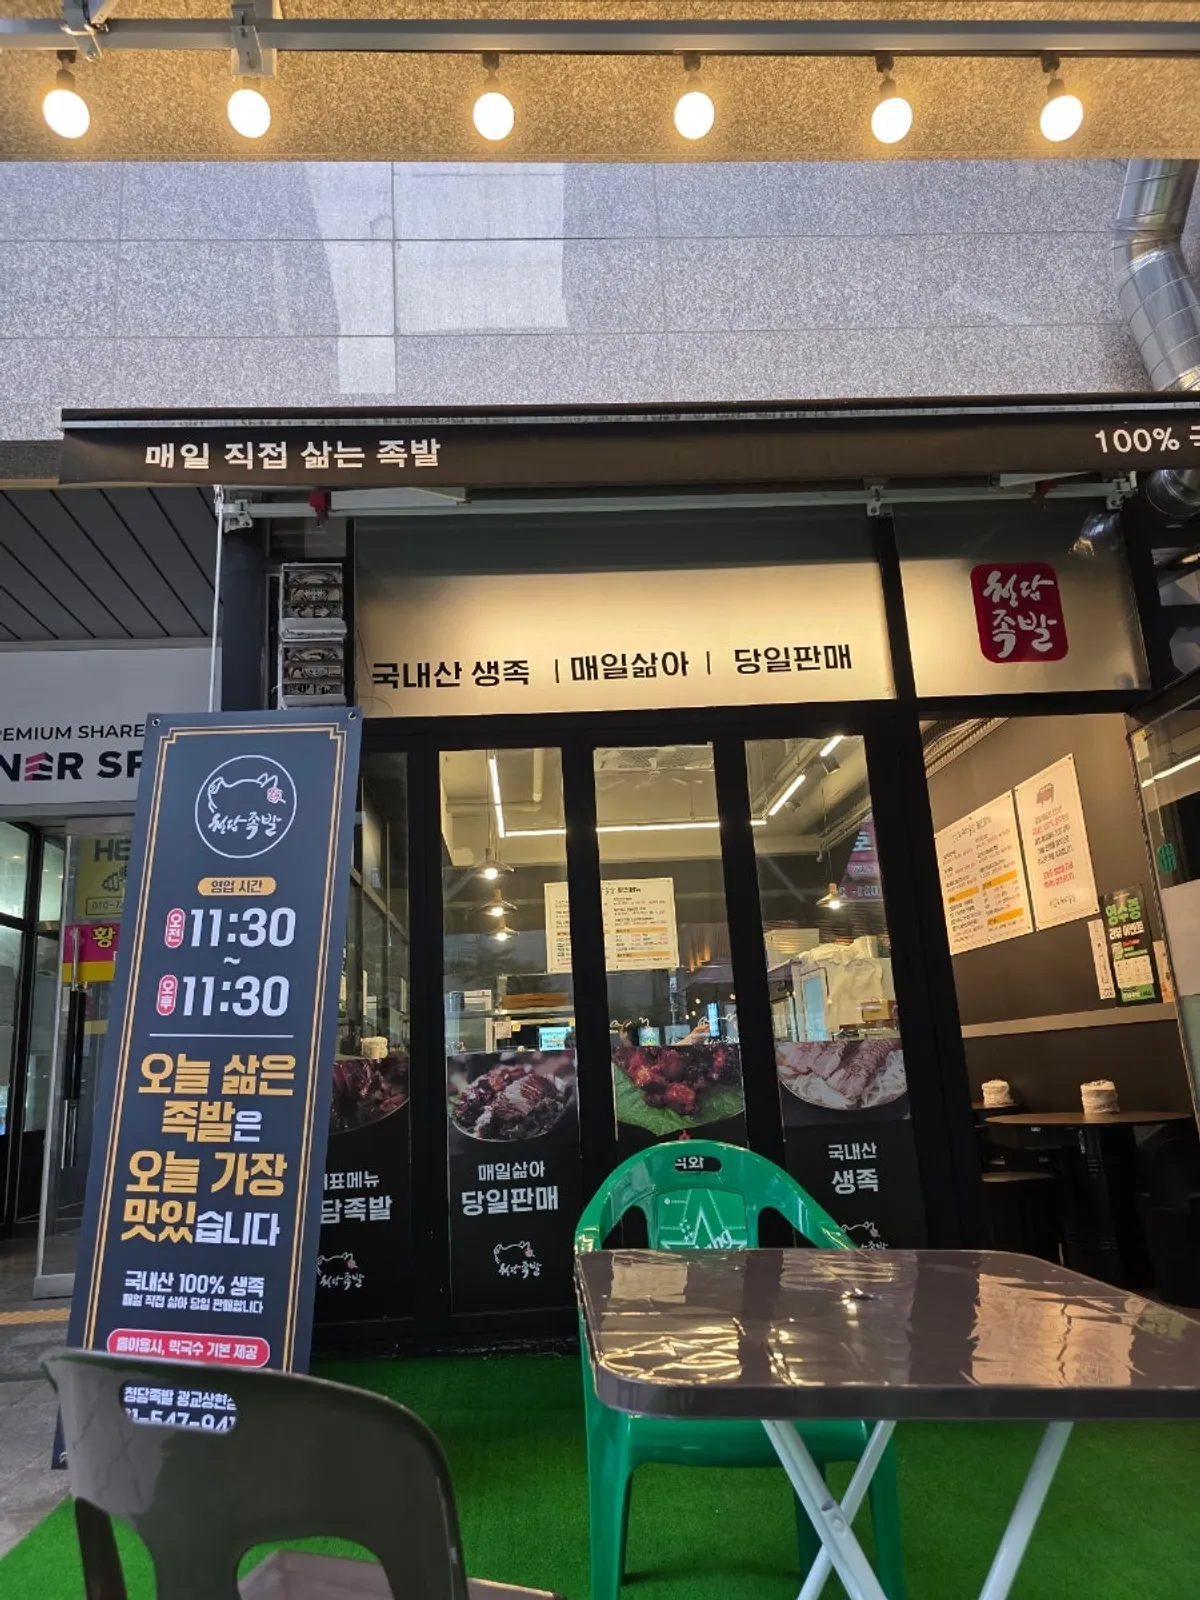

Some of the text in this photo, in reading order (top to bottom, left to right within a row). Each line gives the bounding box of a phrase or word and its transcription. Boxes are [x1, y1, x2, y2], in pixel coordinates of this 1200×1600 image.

[145, 438, 441, 470] 매일 직접 삶는 족발
[1095, 427, 1180, 453] 100%
[992, 609, 1057, 659] 족발
[372, 644, 853, 689] 국내산 생족 매일삶아 당일판매
[0, 724, 145, 741] EMIUM SHARE
[210, 879, 263, 894] 영업 시간
[167, 907, 296, 948] 오전 11:30
[160, 975, 290, 1017] 오후 11:30
[138, 1053, 296, 1096] 오늘 삶은
[161, 1101, 262, 1143] 족발은
[828, 1142, 878, 1161] 국내산
[126, 1150, 288, 1196] 오늘 가장
[323, 1171, 380, 1191] 표메뉴
[478, 1161, 546, 1181] 매일삶아
[831, 1168, 880, 1195] 생족
[320, 1195, 393, 1225] 담족발
[461, 1186, 560, 1217] 당일판매
[120, 1199, 280, 1246] 맛있습니다
[125, 1270, 265, 1298] 국내산 100% 생족
[122, 1293, 264, 1315] 매일 직접 삶아 당일 판매합니다
[169, 1340, 204, 1356] 막국수
[206, 1342, 231, 1359] 기본
[233, 1344, 258, 1360] 제공
[123, 1386, 174, 1407] 청담족발
